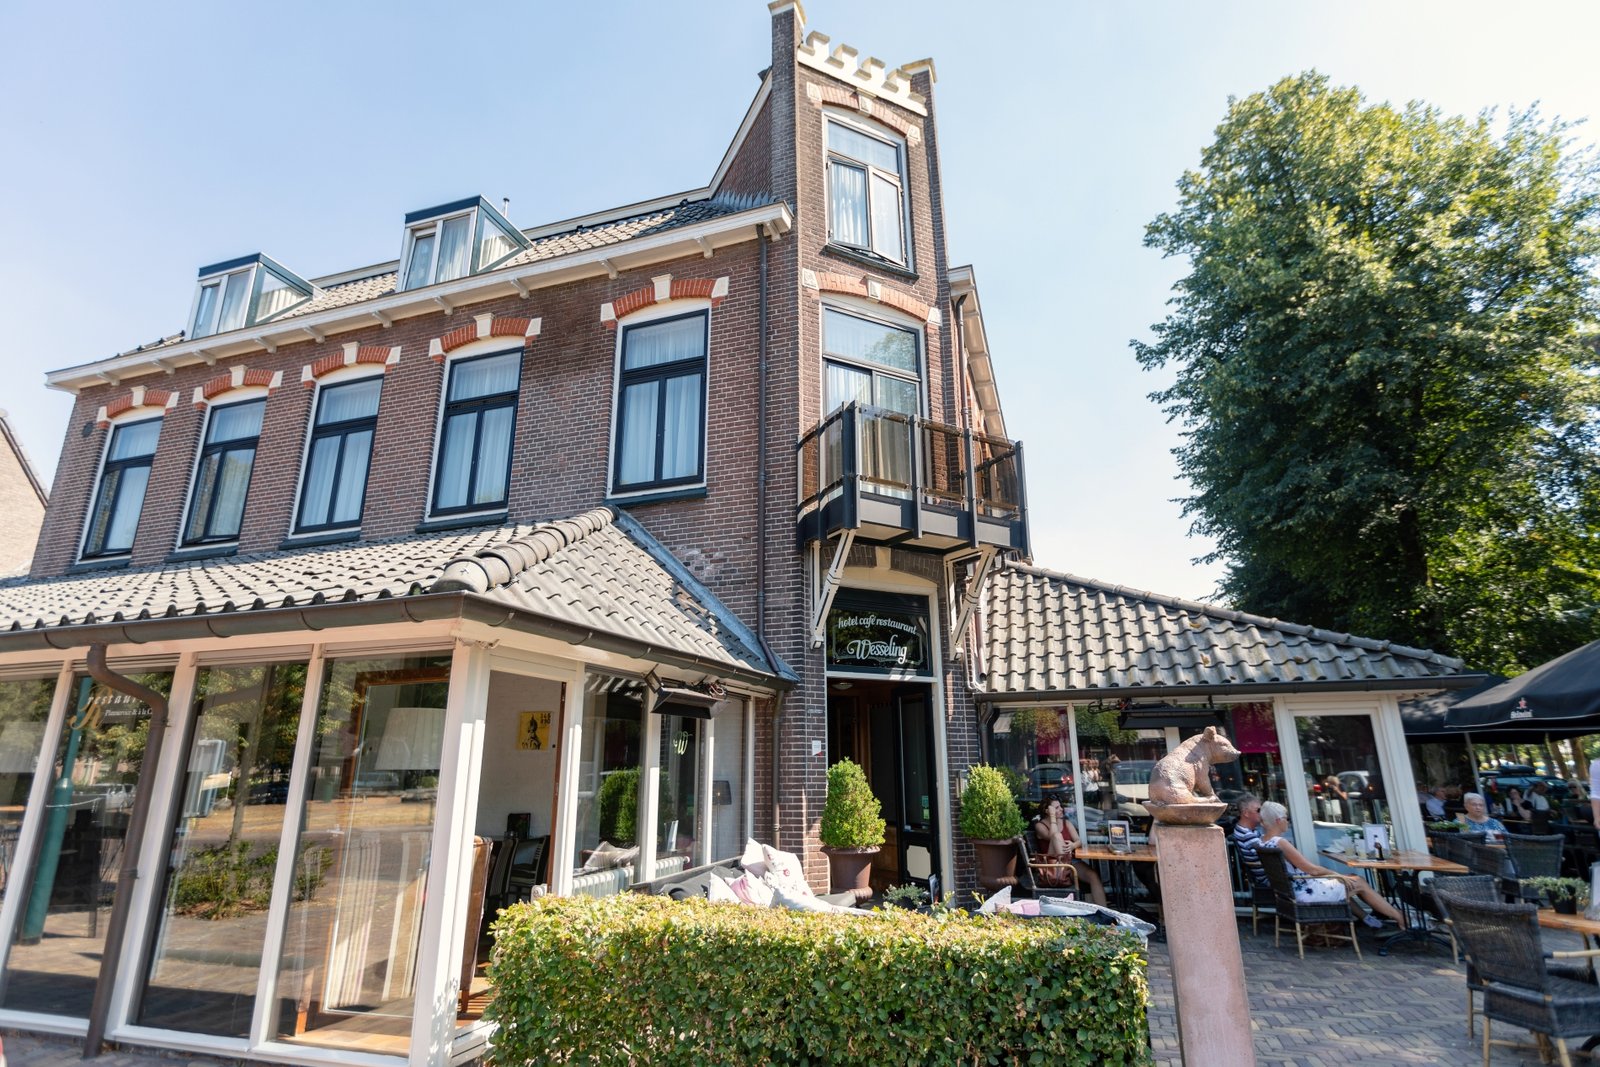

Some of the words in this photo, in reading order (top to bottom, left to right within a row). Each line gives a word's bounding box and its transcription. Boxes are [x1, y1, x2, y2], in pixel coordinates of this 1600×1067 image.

[838, 616, 858, 629] hotel
[860, 614, 876, 628] café
[876, 618, 917, 635] restaurant
[846, 634, 907, 664] Wesseling
